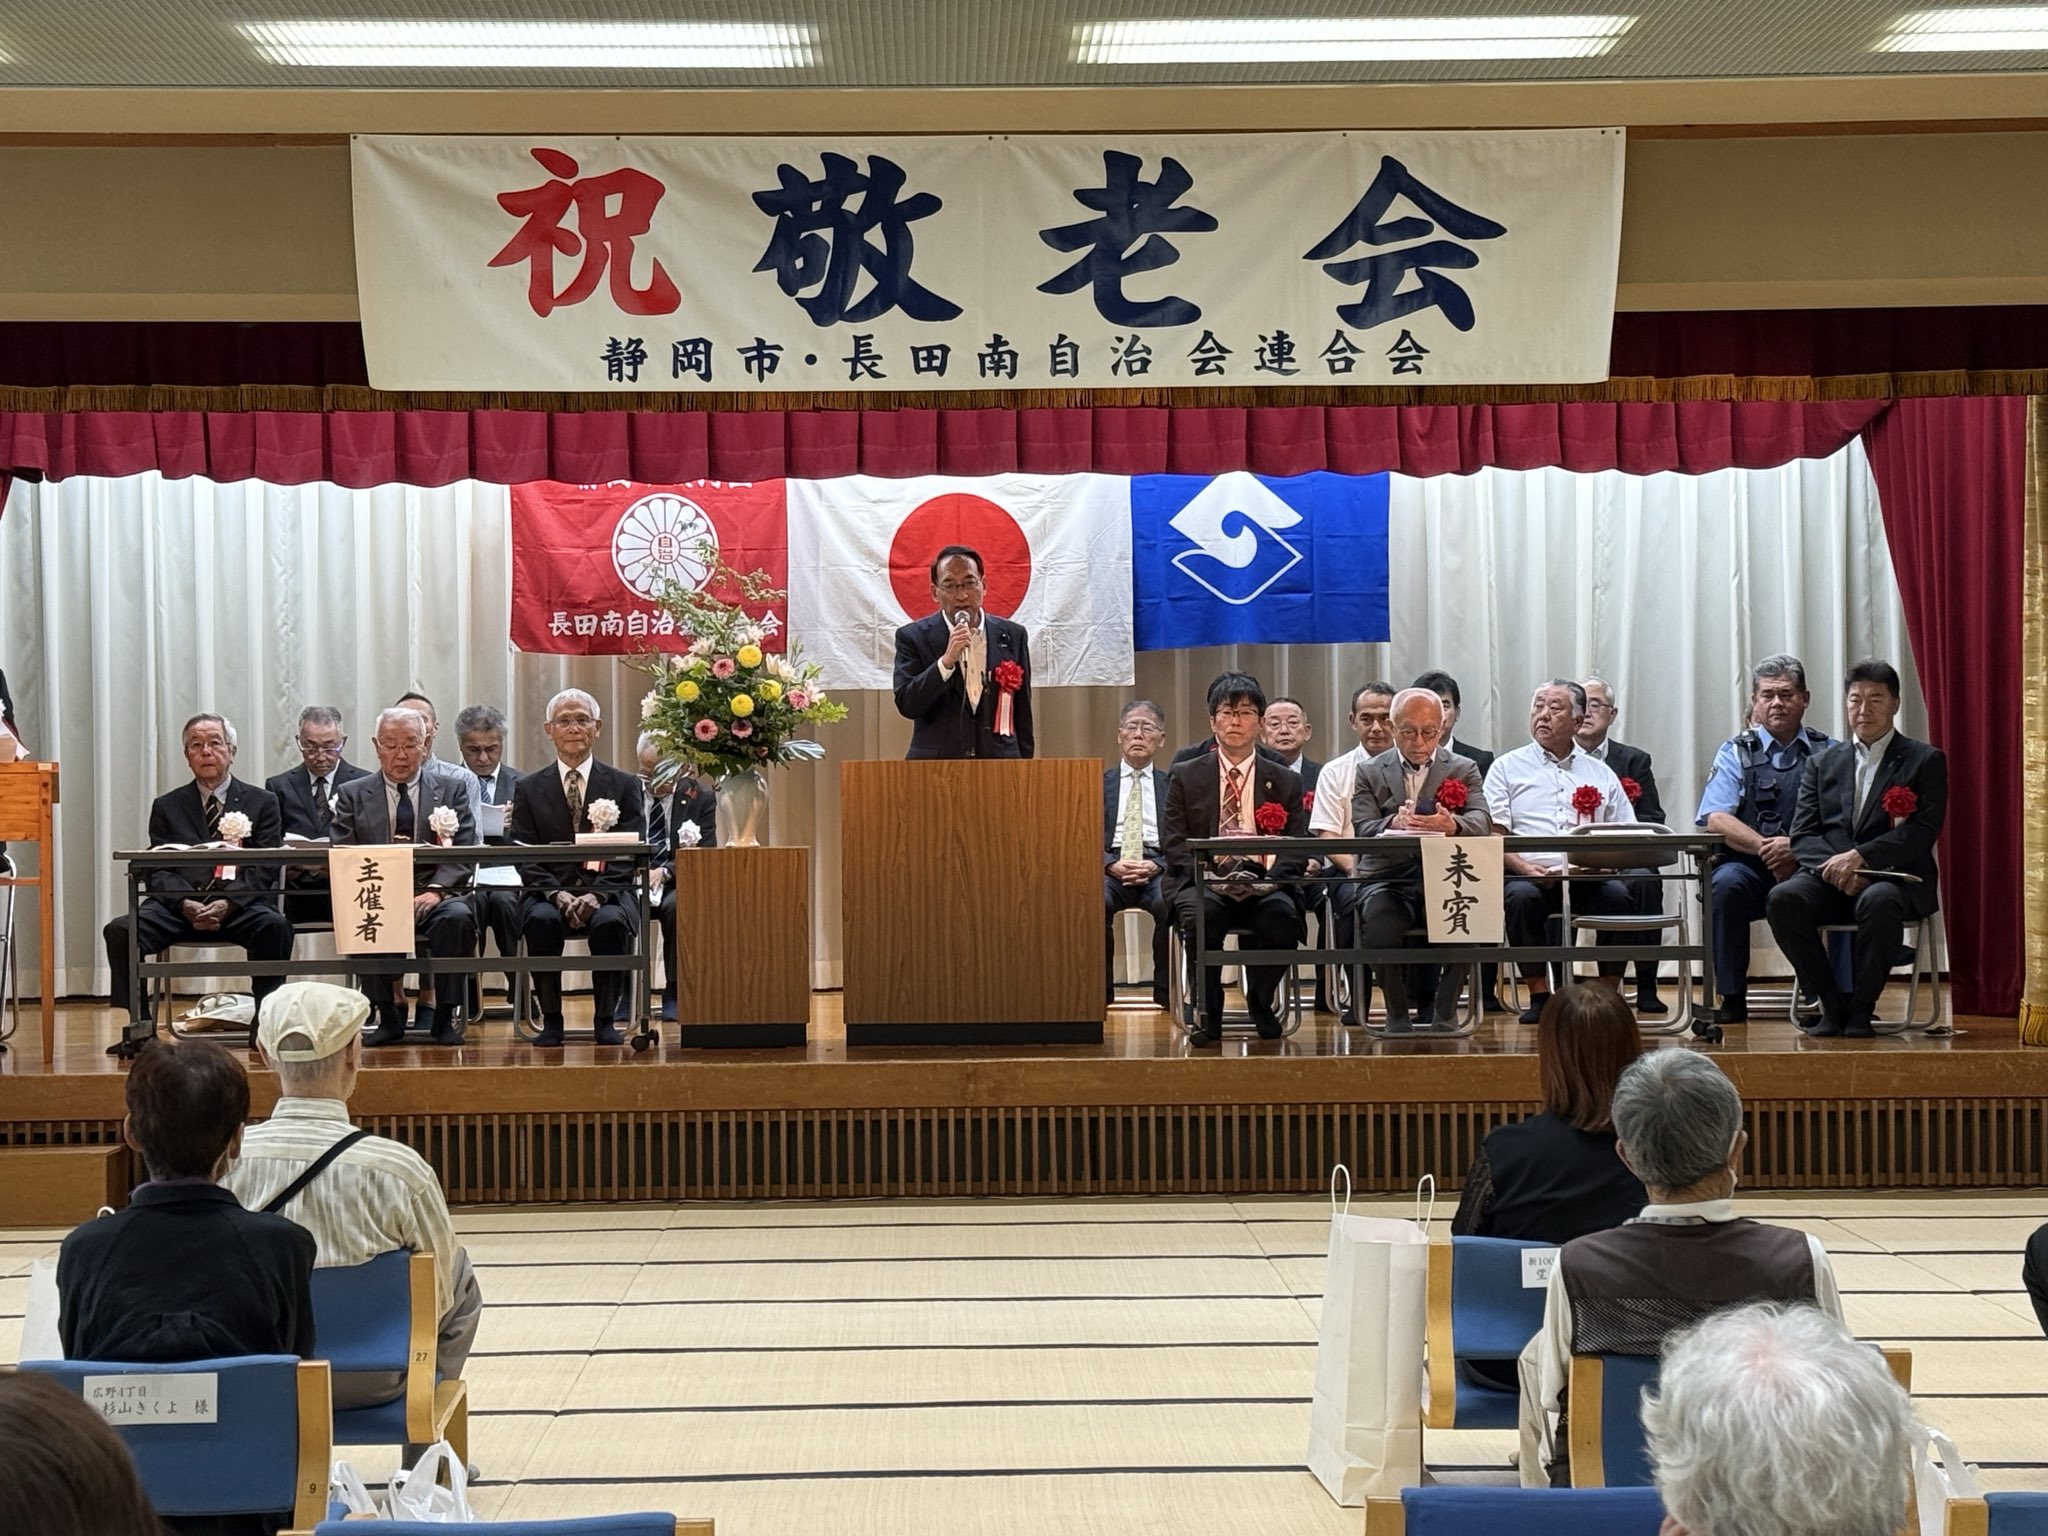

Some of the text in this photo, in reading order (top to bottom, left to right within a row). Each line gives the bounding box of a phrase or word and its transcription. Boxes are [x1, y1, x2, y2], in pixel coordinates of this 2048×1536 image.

[599, 329, 1431, 385] 静岡市・長田南自治会連合会
[353, 857, 386, 944] 主催者
[1442, 843, 1482, 936] 来賓
[415, 1352, 428, 1362] 27
[195, 1398, 209, 1415] 様
[308, 1482, 317, 1495] 9
